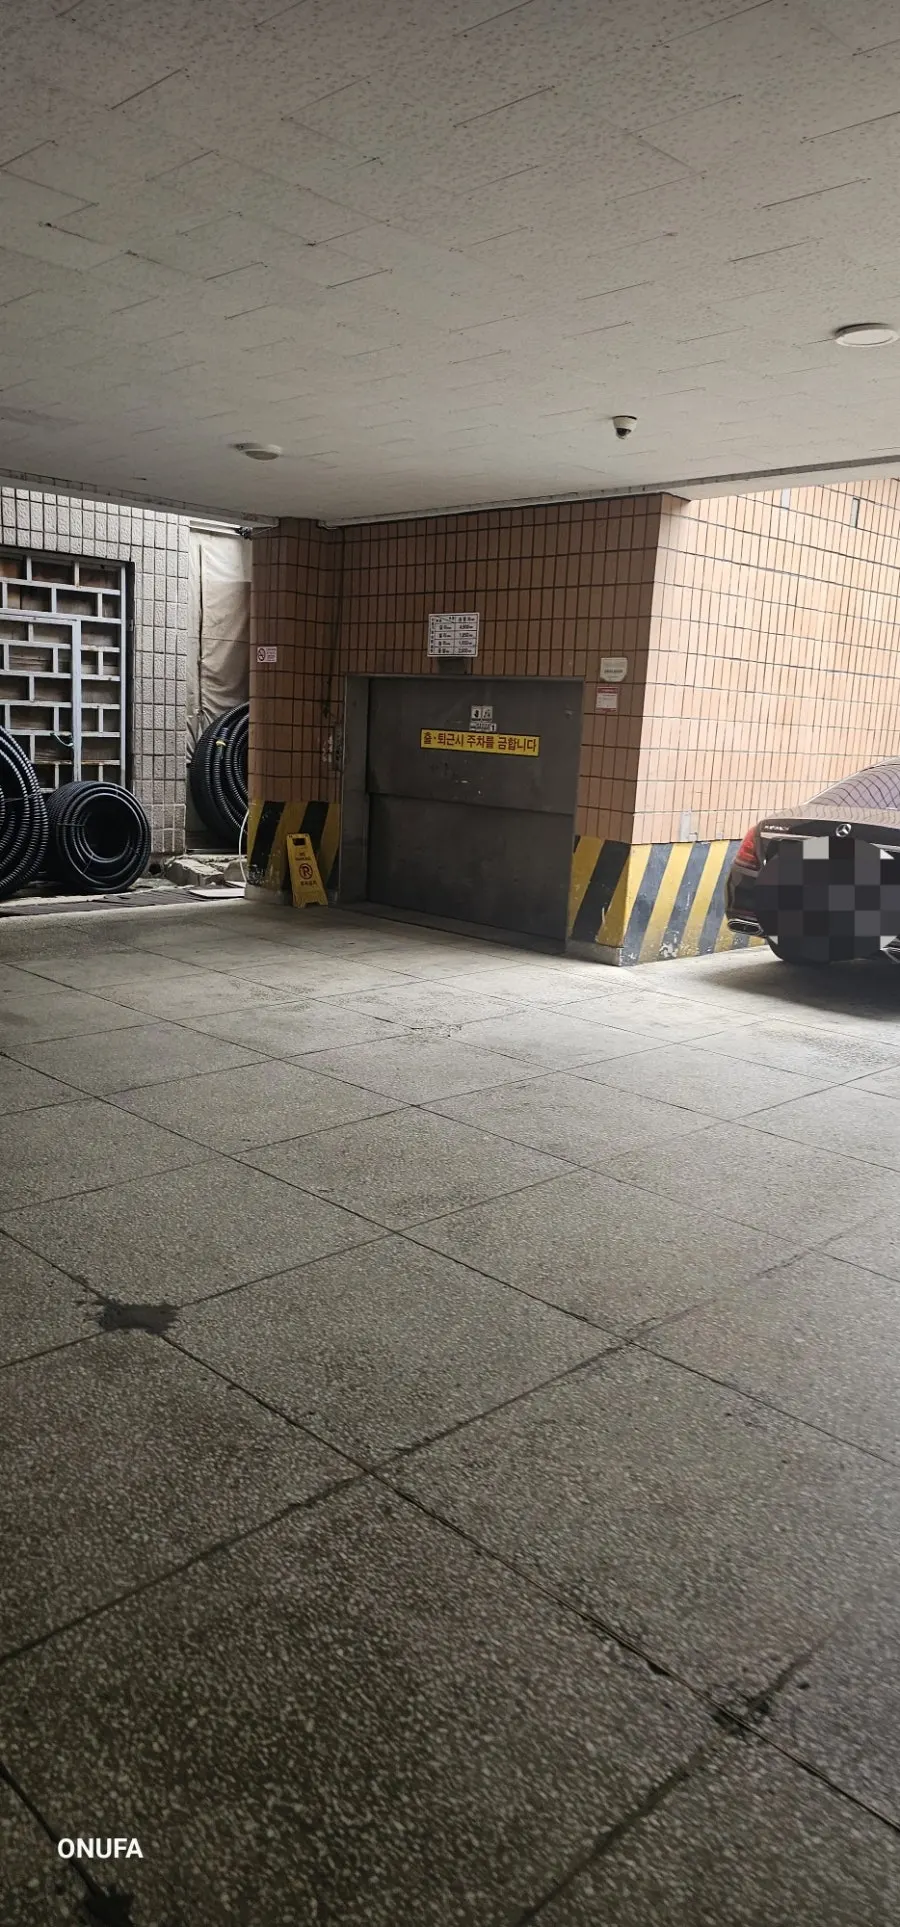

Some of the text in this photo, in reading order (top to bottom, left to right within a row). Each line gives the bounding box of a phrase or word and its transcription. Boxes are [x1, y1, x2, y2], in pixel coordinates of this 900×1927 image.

[423, 731, 537, 752] 출·퇴근시 주차를 금합니다
